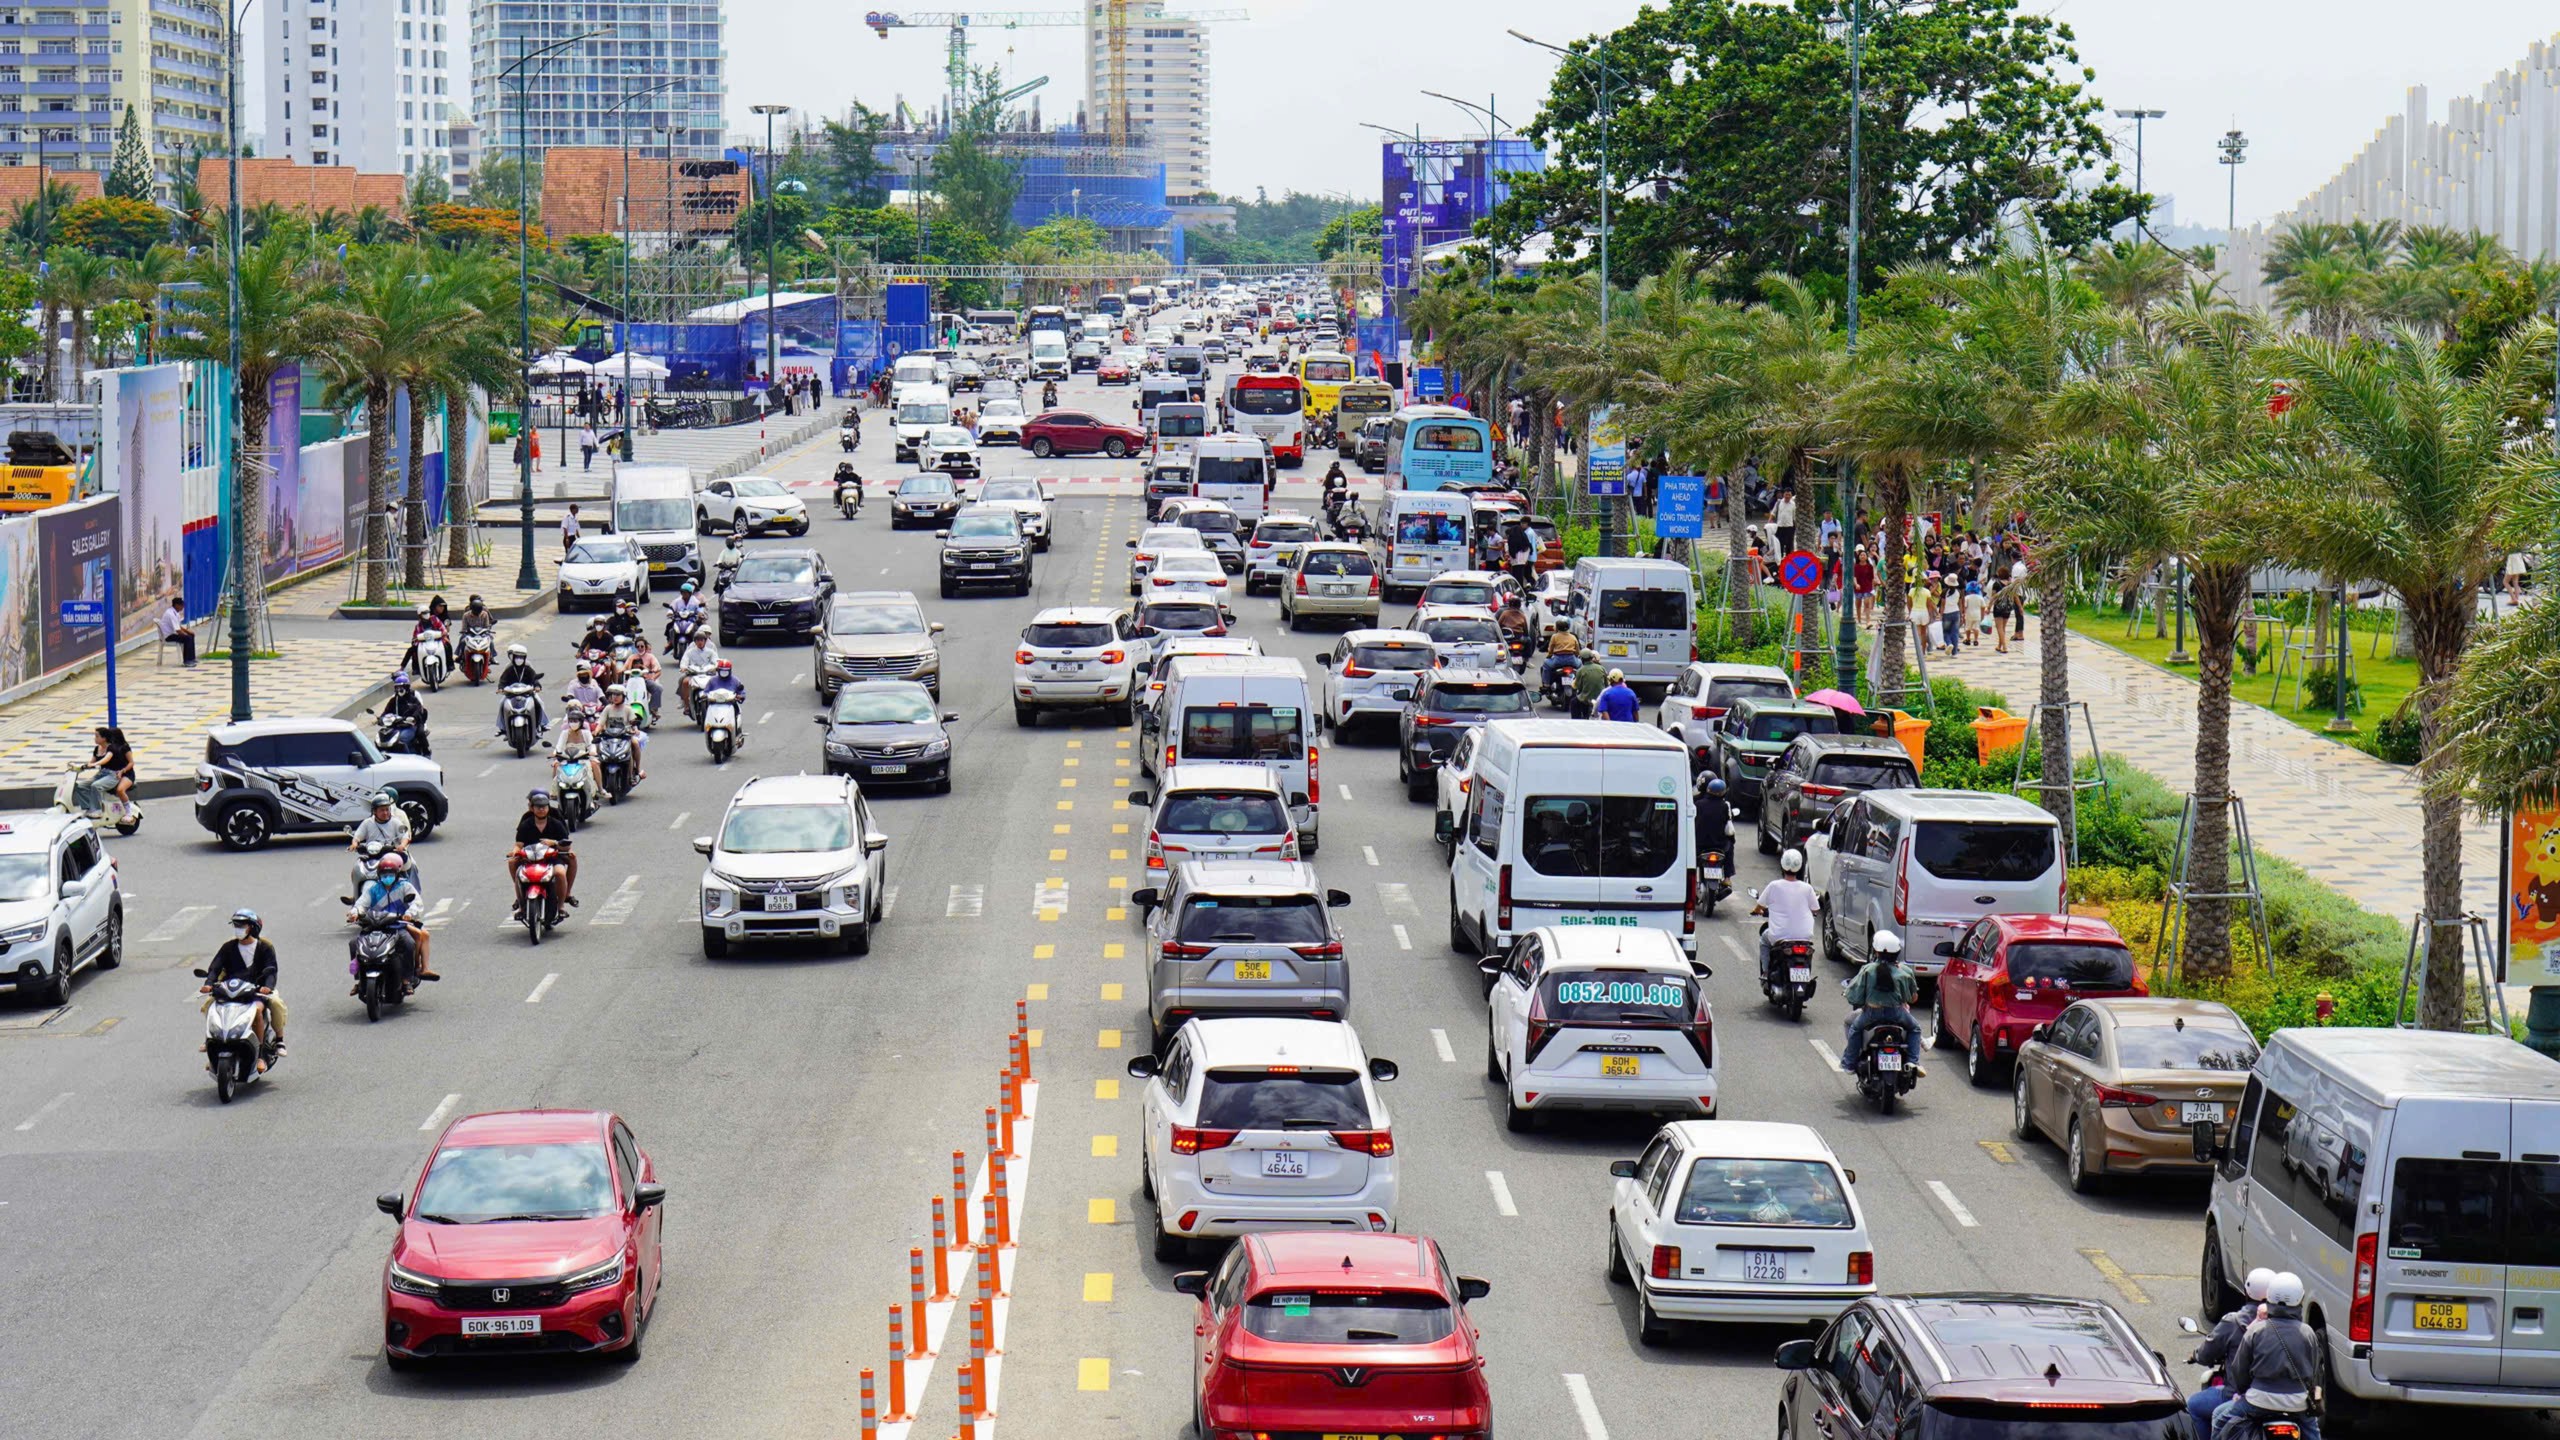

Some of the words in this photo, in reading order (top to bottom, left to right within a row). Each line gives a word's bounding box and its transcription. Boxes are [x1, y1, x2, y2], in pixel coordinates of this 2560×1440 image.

[781, 366, 814, 375] YAMAHA
[1664, 482, 1678, 490] PHÍA
[1678, 481, 1698, 490] TRƯỚC
[1671, 493, 1691, 502] AHEAD
[1674, 504, 1686, 512] 50m
[1659, 513, 1676, 522] CÔNG
[1676, 513, 1701, 523] TRƯỜNG
[1669, 526, 1690, 534] WORKS
[72, 536, 89, 557] SALES
[89, 529, 111, 552] GALLERY
[1245, 962, 1260, 970] 50E
[1238, 971, 1267, 980] 935.84
[1559, 982, 1683, 1007] 0852.000.808
[1612, 1056, 1630, 1065] 60H
[1605, 1065, 1637, 1075] 369.43
[2194, 1102, 2212, 1112] 70A
[1275, 1152, 1295, 1163] 51L
[1267, 1163, 1303, 1174] 464.46
[1754, 1253, 1777, 1266] 61A
[1746, 1266, 1785, 1280] 122.26
[2401, 1268, 2449, 1278] TRANSIT
[1294, 1296, 1310, 1304] ĐỒNG
[2430, 1304, 2453, 1316] 60B
[467, 1318, 535, 1334] 60K-961.09
[2420, 1316, 2463, 1329] 044.83
